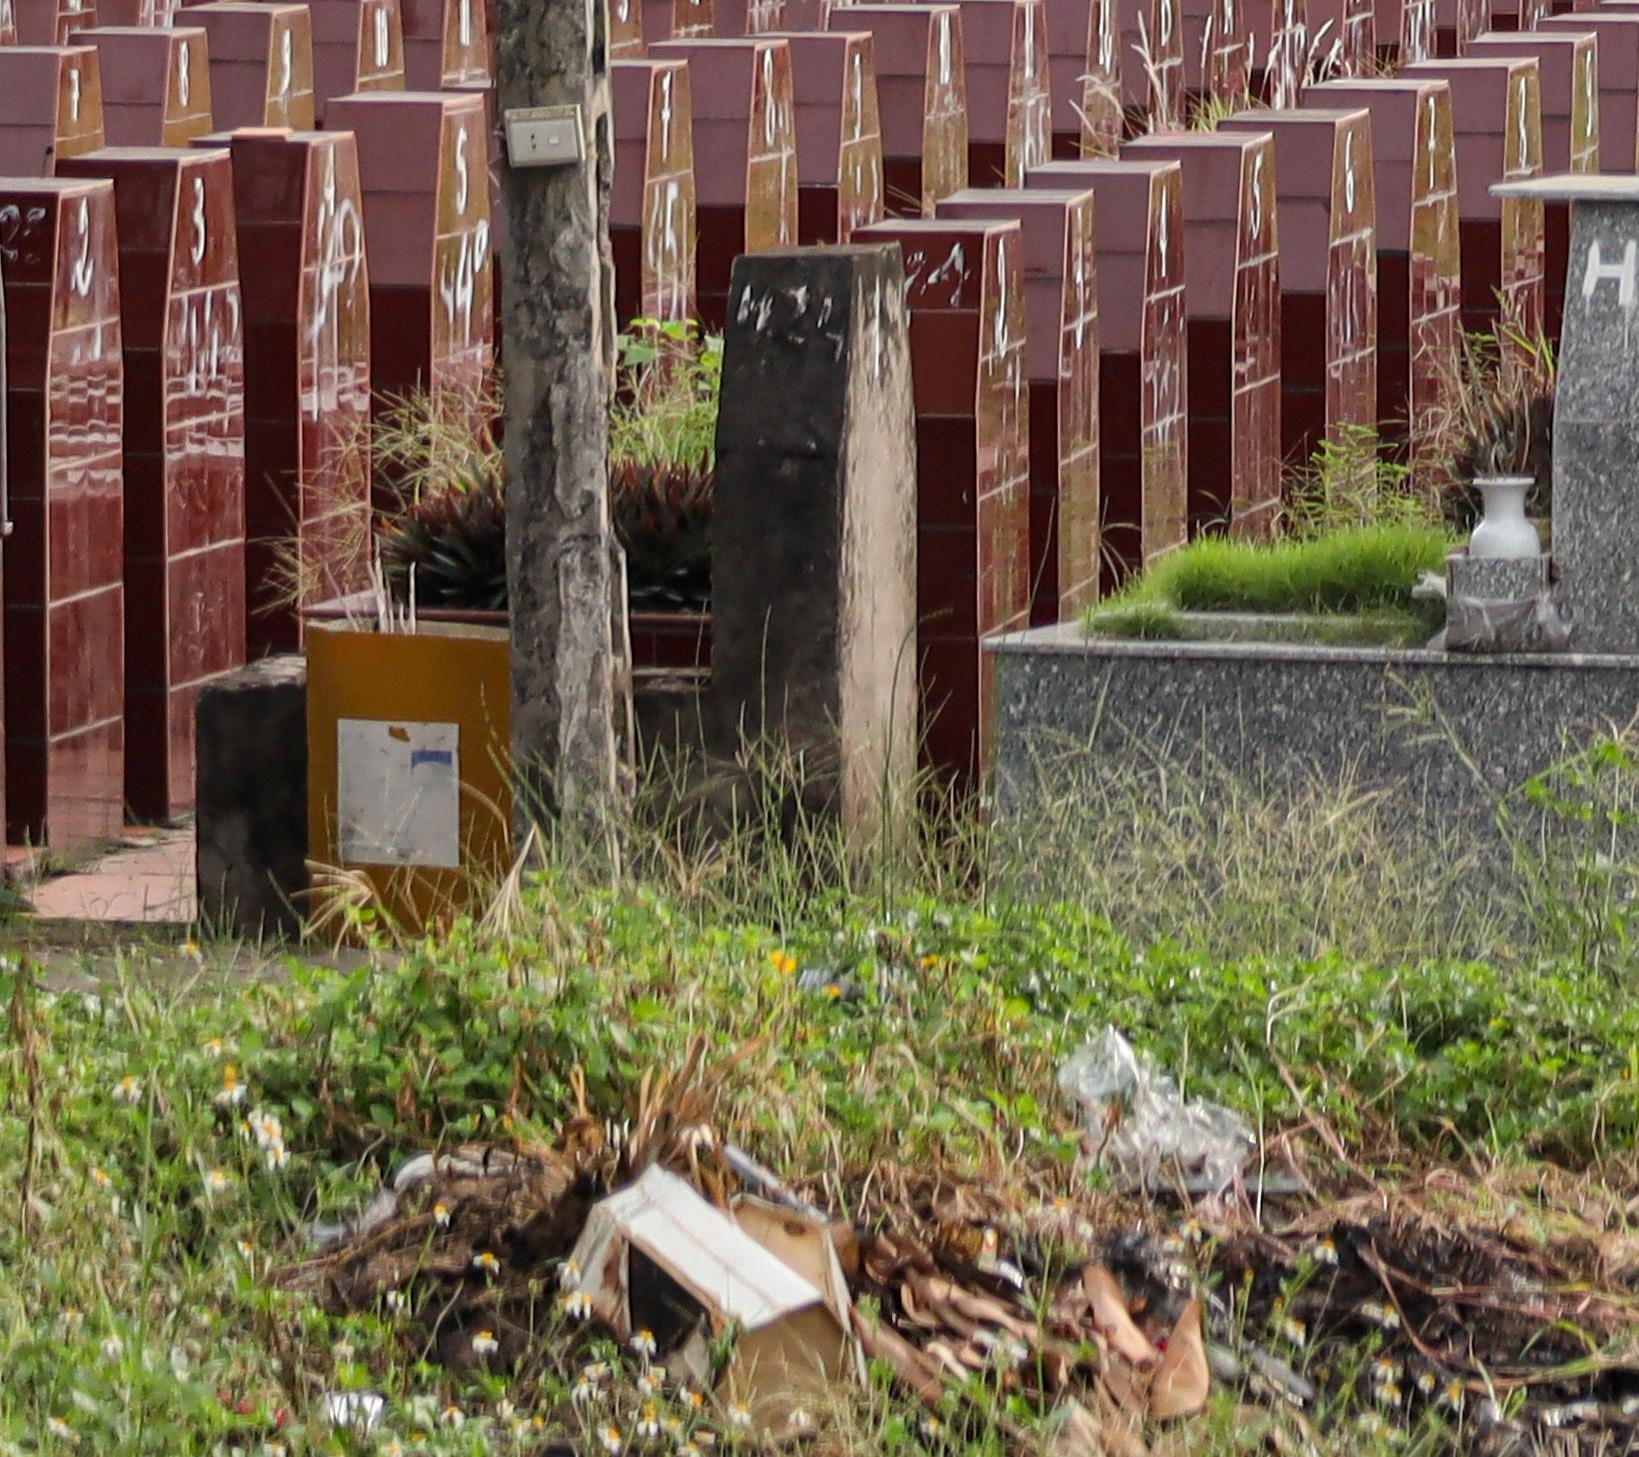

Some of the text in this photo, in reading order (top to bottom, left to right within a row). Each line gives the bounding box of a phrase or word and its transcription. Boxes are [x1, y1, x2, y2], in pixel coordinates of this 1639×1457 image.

[455, 127, 468, 217] 5
[72, 196, 94, 298] 2
[190, 178, 206, 267] 3
